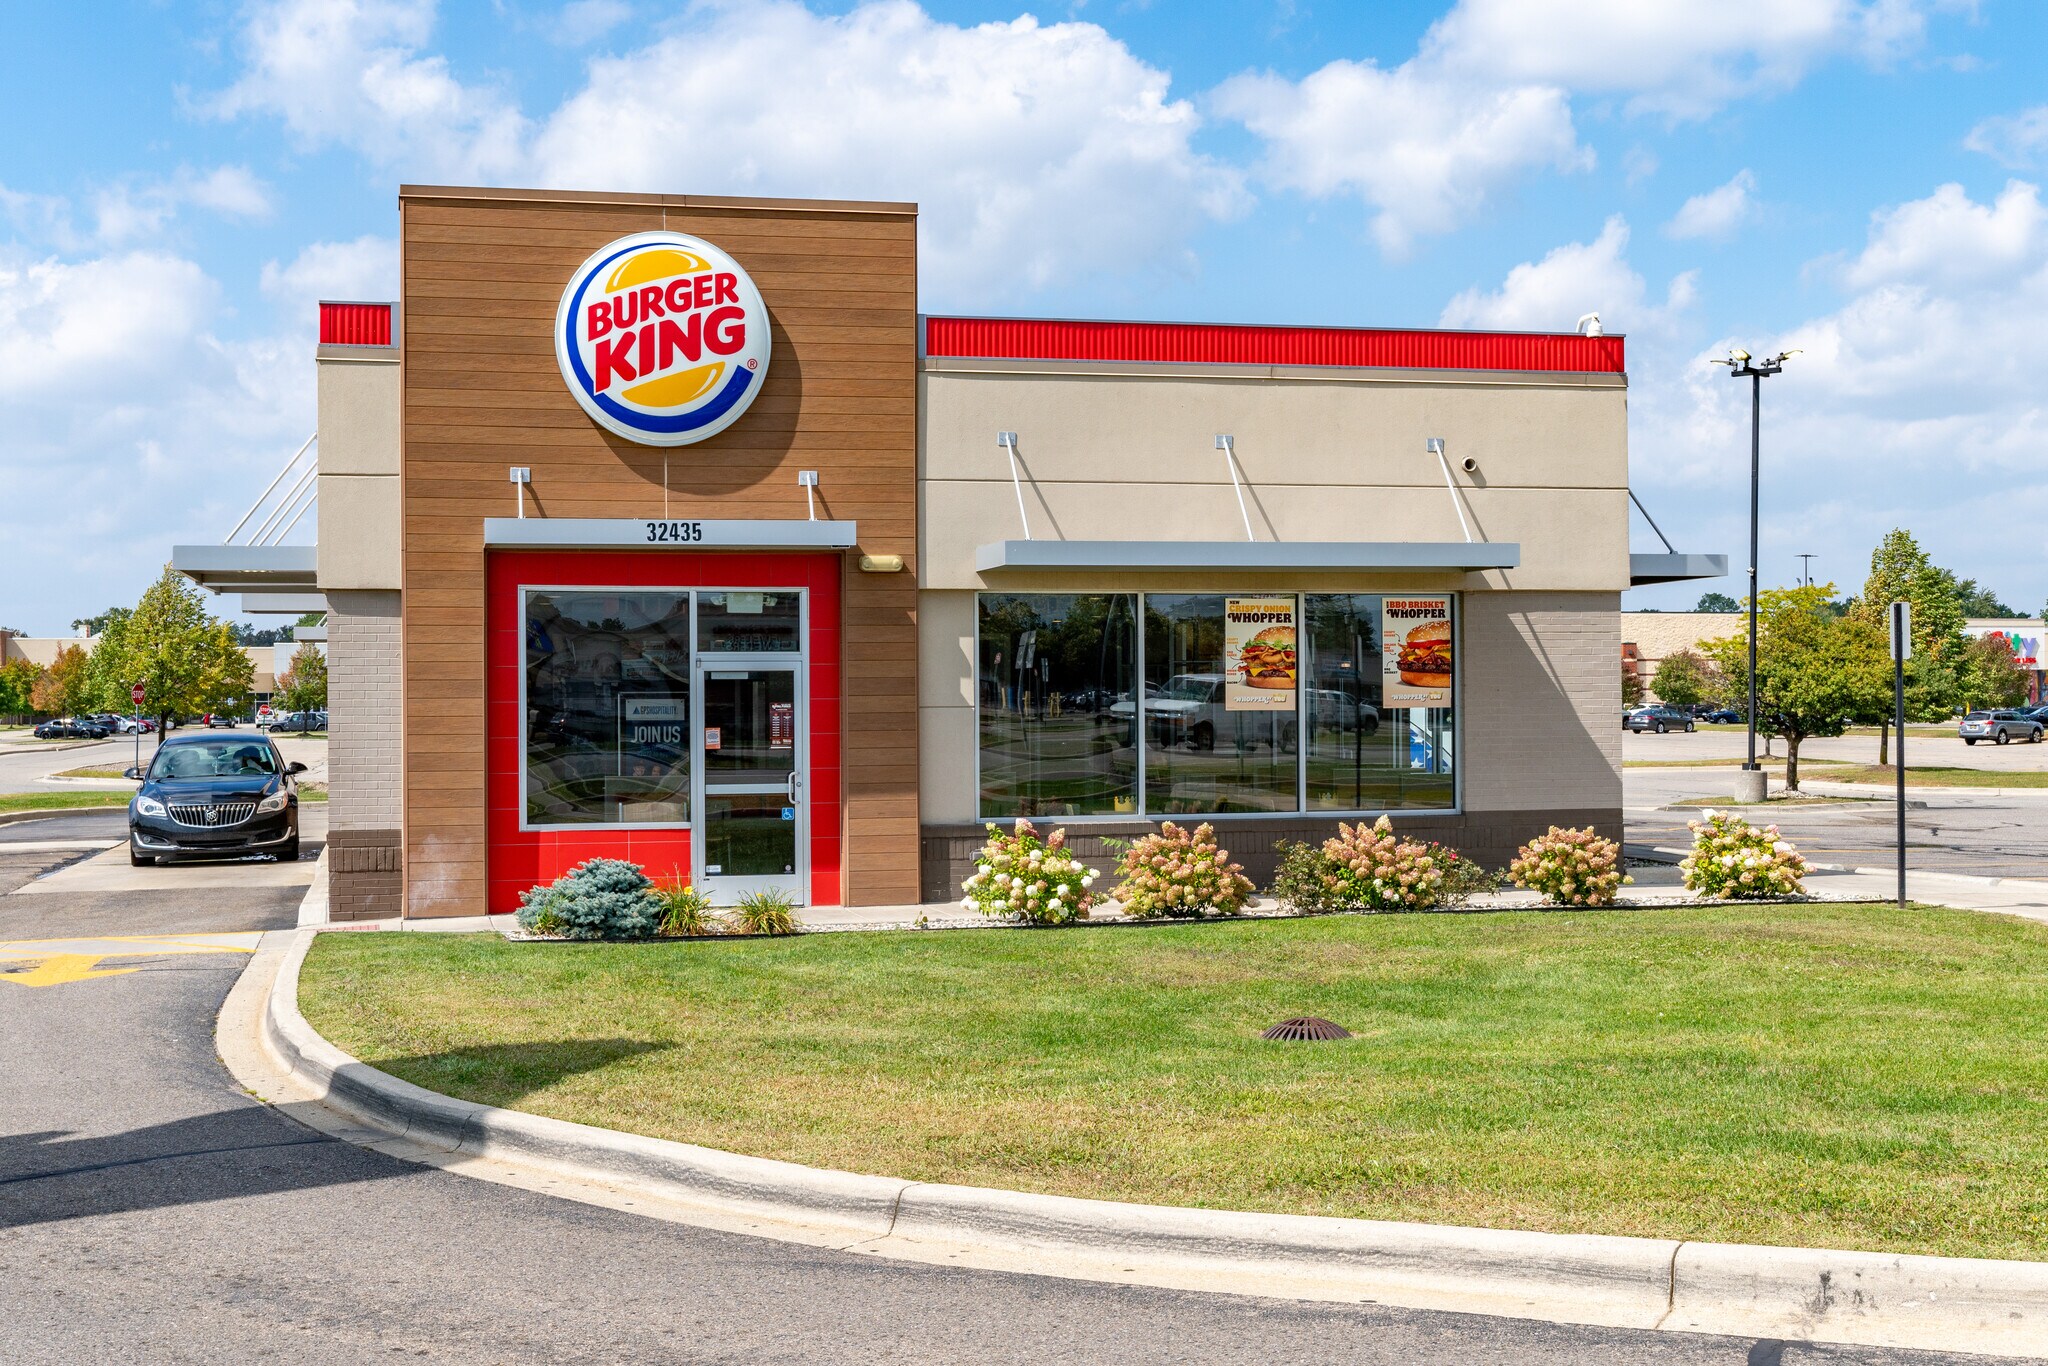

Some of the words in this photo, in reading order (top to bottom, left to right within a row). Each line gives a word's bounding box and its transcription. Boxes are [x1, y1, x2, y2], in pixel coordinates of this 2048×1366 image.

[588, 272, 740, 342] BURGER
[595, 306, 746, 393] KING
[646, 522, 702, 542] 32435
[1390, 601, 1407, 609] BBQ
[1227, 612, 1292, 623] WHOPPER
[1386, 608, 1446, 618] WHOPPER
[132, 690, 145, 699] STOP
[631, 726, 661, 743] JOIN
[663, 726, 681, 743] US
